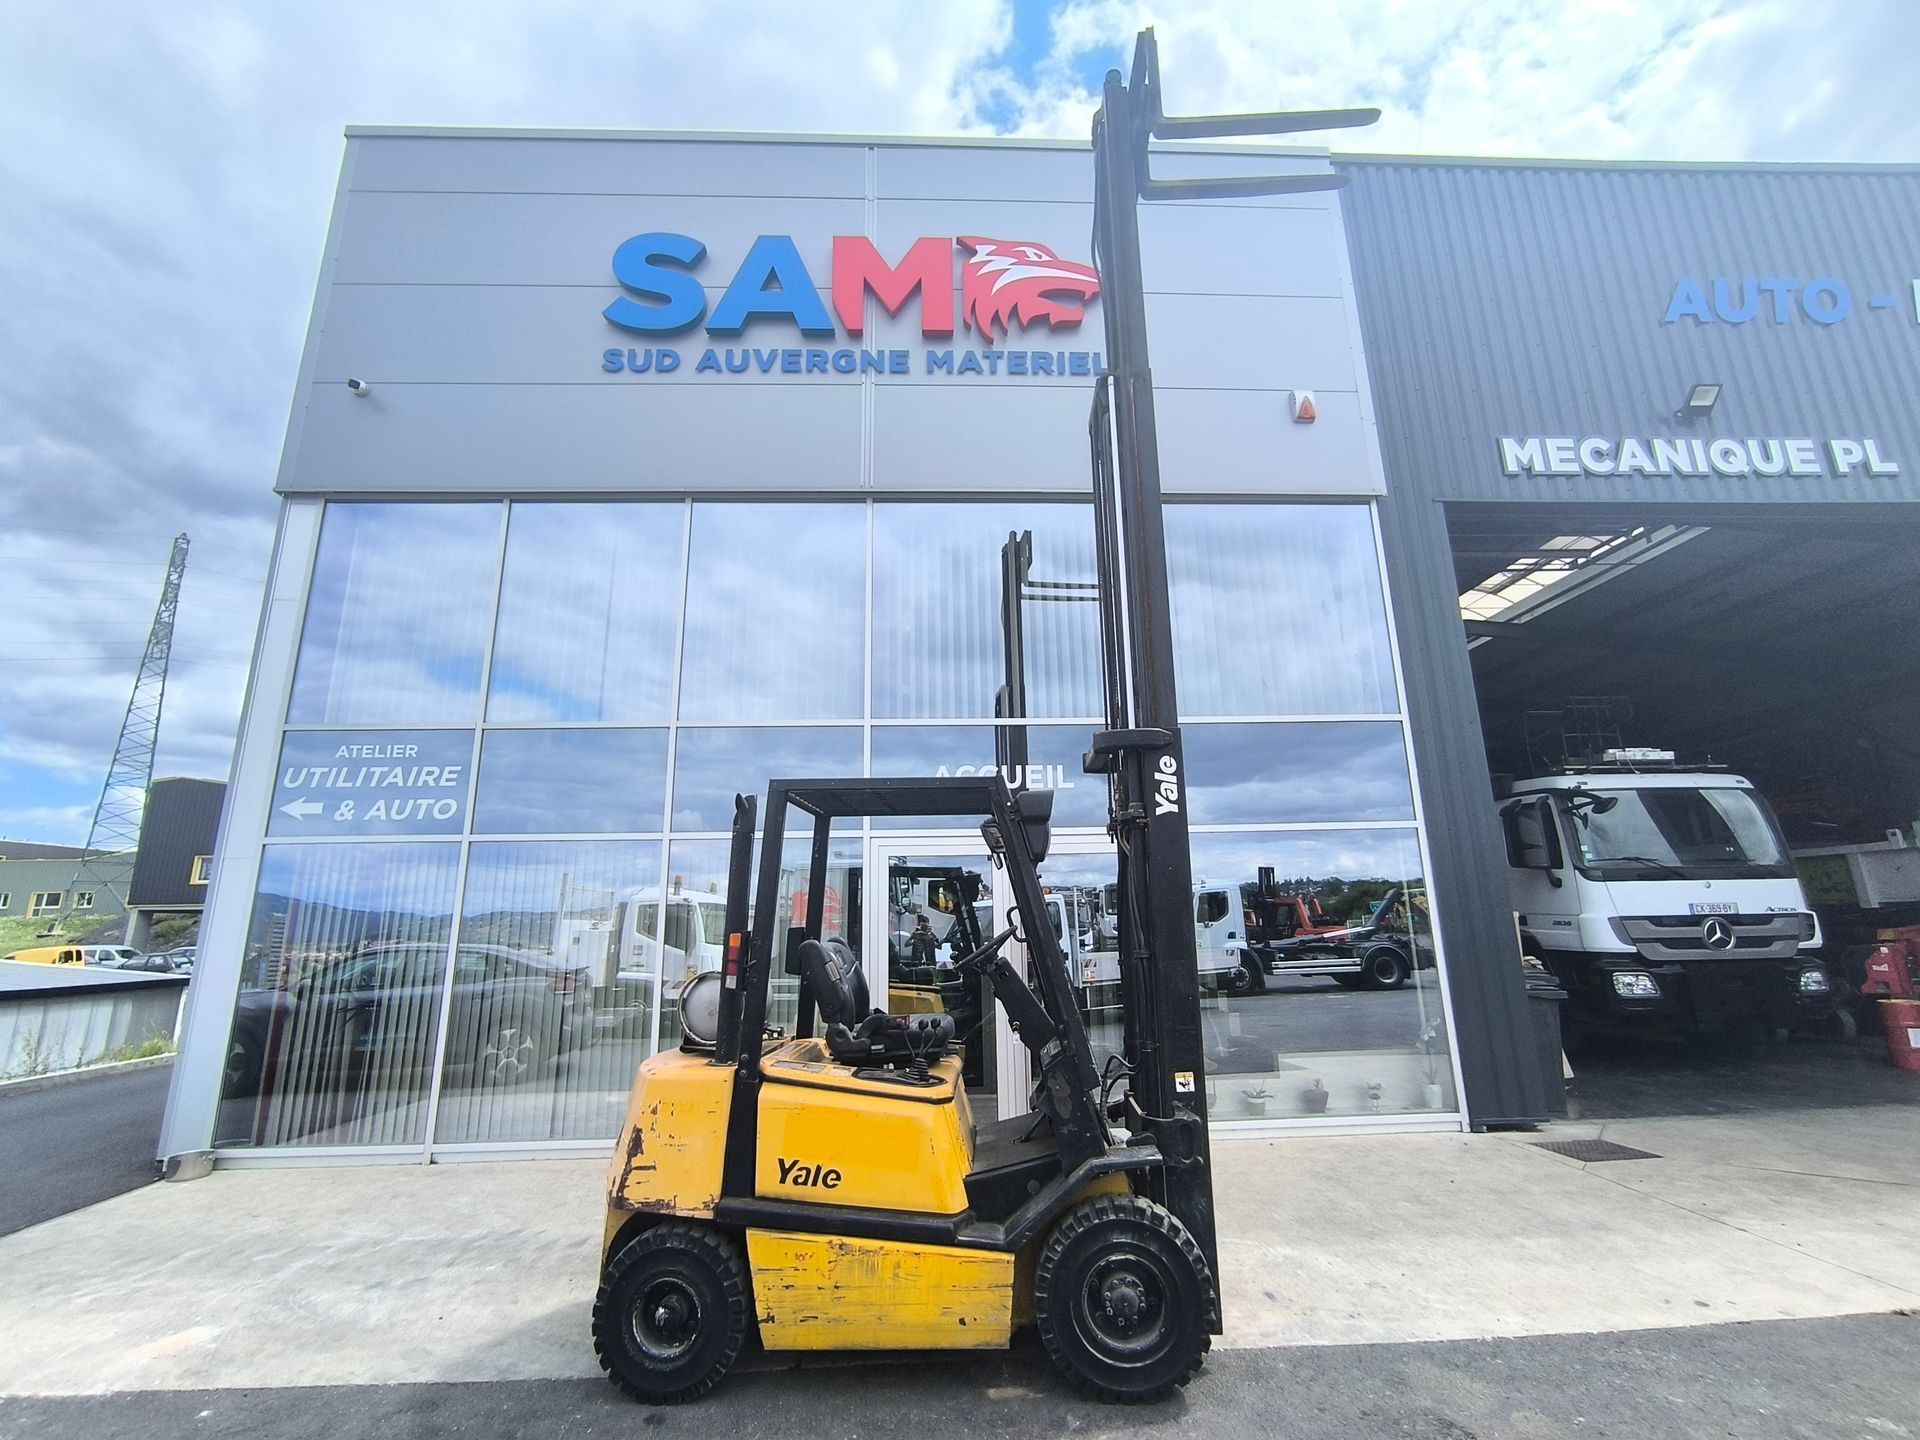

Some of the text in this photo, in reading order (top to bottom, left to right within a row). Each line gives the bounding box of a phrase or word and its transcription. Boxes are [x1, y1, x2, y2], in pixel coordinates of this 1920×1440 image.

[602, 232, 953, 336] SAM
[1666, 277, 1852, 324] AUTO
[602, 348, 1107, 376] SUD AUVERGNE MATERIEL
[1500, 436, 1899, 476] MECANIQUE PL
[335, 744, 418, 758] ATELIER
[283, 766, 462, 788] UTILITAIRE
[1154, 755, 1179, 816] Yale
[334, 799, 458, 821] & AUTO
[777, 1158, 842, 1189] Yale
